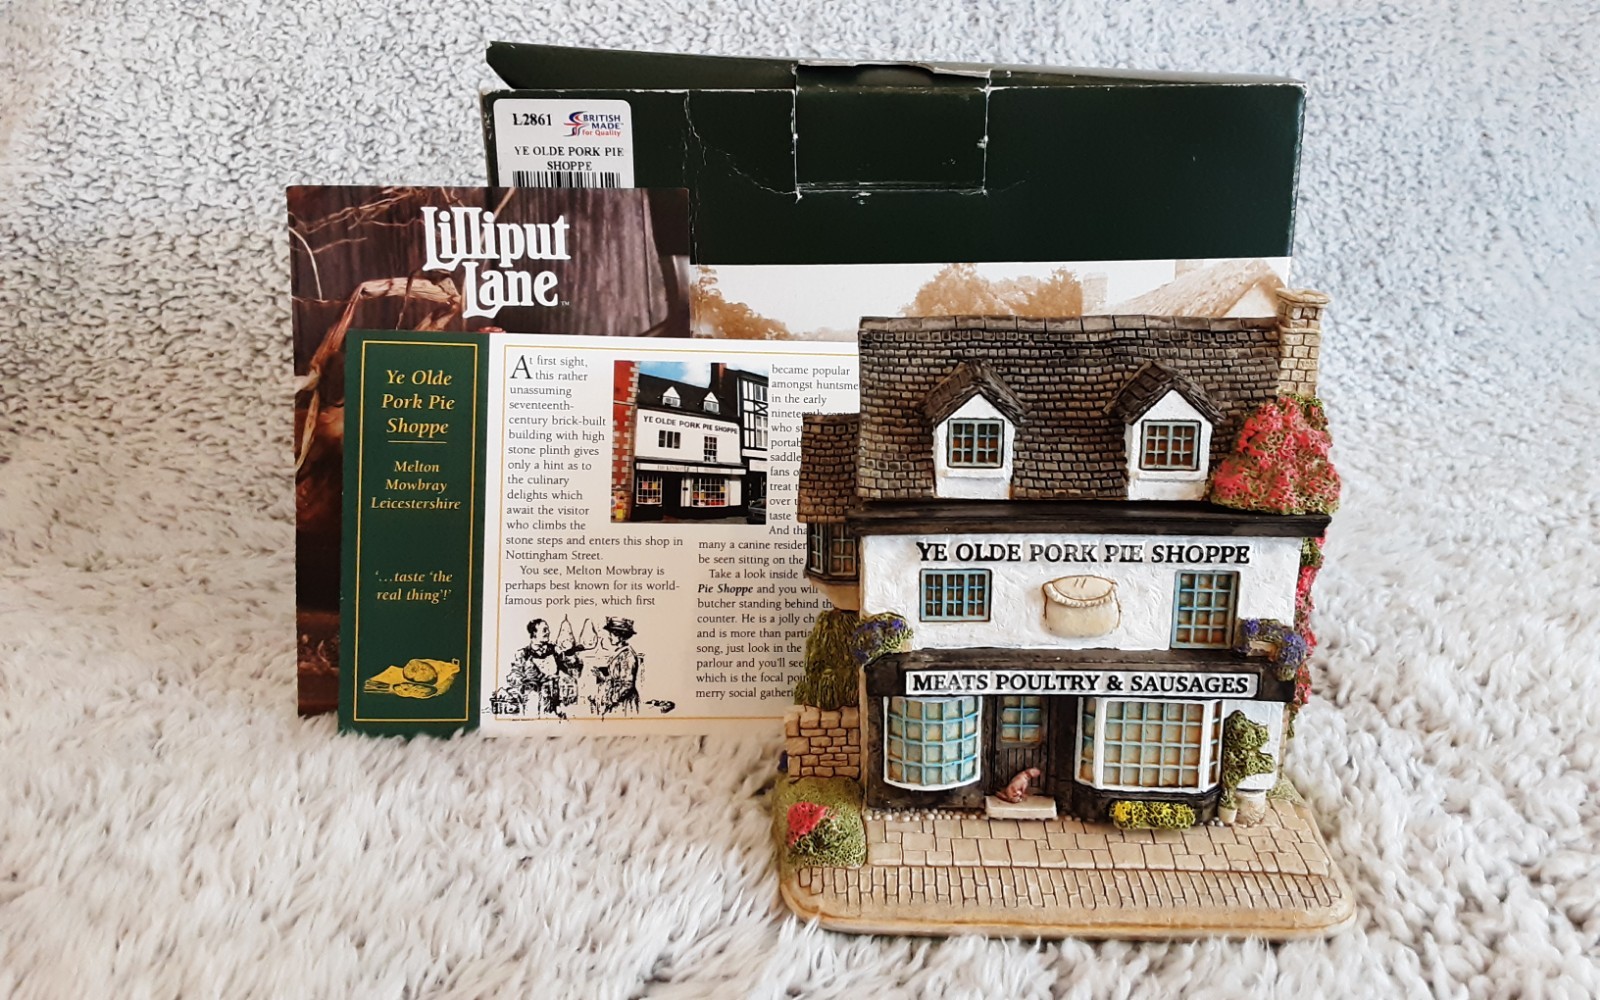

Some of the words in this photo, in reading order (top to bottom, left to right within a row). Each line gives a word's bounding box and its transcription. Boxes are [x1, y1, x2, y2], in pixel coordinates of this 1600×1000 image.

[513, 113, 552, 125] L2861
[515, 146, 529, 155] YE
[533, 147, 564, 155] OLDE
[568, 147, 600, 156] PORK
[605, 148, 624, 156] PIE
[547, 161, 592, 170] SHOPPE
[421, 206, 571, 271] Lilliput
[462, 262, 558, 319] Lane
[537, 356, 556, 365] first
[560, 357, 588, 368] sight,
[772, 364, 808, 374] became
[813, 366, 850, 377] popular
[386, 369, 405, 384] Ye
[412, 369, 452, 385] Olde
[536, 372, 554, 380] this
[558, 372, 588, 381] rather
[771, 380, 812, 391] amongst
[817, 379, 858, 389] huntsme
[510, 386, 572, 397] unassuming
[381, 393, 422, 409] Pork
[428, 395, 455, 409] Pie
[509, 401, 574, 410] seventeenth-
[785, 395, 799, 403] the
[804, 395, 827, 405] early
[509, 417, 547, 427] century
[552, 416, 606, 426] brick-built
[655, 416, 676, 426] OLDE
[679, 420, 700, 429] PORK
[715, 424, 738, 434] SHOPPE
[386, 417, 449, 438] Shoppe
[771, 424, 792, 432] who
[509, 431, 552, 442] building
[556, 432, 578, 440] with
[583, 432, 604, 443] high
[508, 446, 535, 454] stone
[540, 446, 570, 457] plinth
[574, 447, 599, 457] gives
[394, 460, 440, 472] Melton
[508, 461, 531, 472] only
[534, 462, 539, 470] a
[544, 461, 563, 470] hint
[582, 462, 591, 470] to
[770, 467, 789, 477] fans
[385, 479, 447, 494] Mowbray
[508, 475, 524, 484] the
[527, 476, 569, 487] culinary
[770, 483, 791, 491] treat
[507, 491, 547, 501] delights
[552, 492, 583, 500] which
[371, 497, 461, 509] Leicestershire
[507, 506, 533, 514] await
[538, 506, 553, 515] the
[558, 507, 589, 515] visitor
[770, 512, 791, 521] taste
[507, 520, 529, 529] who
[533, 521, 566, 530] climbs
[570, 521, 585, 530] the
[769, 526, 789, 535] And
[506, 536, 533, 544] stone
[537, 536, 563, 547] steps
[566, 536, 585, 545] and
[623, 536, 641, 545] this
[645, 536, 670, 547] shop
[699, 542, 726, 550] many
[506, 550, 567, 562] Nottingham
[572, 551, 603, 560] Street.
[916, 541, 948, 562] YE
[956, 543, 1021, 562] OLDE
[1029, 544, 1097, 563] PORK
[1104, 545, 1143, 563] PIE
[1151, 545, 1251, 564] SHOPPE
[699, 554, 710, 563] be
[739, 555, 769, 566] sitting
[789, 554, 803, 564] the
[520, 566, 539, 575] You
[566, 566, 601, 575] Melton
[606, 566, 653, 577] Mowbray
[657, 567, 664, 575] is
[709, 569, 731, 578] Take
[744, 569, 765, 579] look
[769, 569, 798, 579] inside
[505, 581, 546, 592] perhaps
[550, 581, 570, 590] best
[574, 581, 609, 590] known
[613, 581, 627, 590] for
[631, 581, 642, 590] its
[645, 581, 680, 590] world-
[698, 584, 713, 593] Pie
[717, 584, 753, 595] Shoppe
[757, 584, 775, 593] and
[779, 586, 797, 595] you
[377, 588, 402, 600] real
[505, 595, 542, 605] famous
[546, 596, 570, 607] pork
[574, 596, 597, 607] pies,
[602, 596, 631, 605] which
[636, 596, 655, 605] first
[698, 599, 736, 608] butcher
[739, 599, 781, 610] standing
[785, 599, 818, 608] behind
[697, 615, 737, 624] counter.
[742, 614, 755, 623] He
[759, 615, 766, 623] is
[778, 614, 799, 625] jolly
[697, 629, 715, 638] and
[719, 629, 726, 638] is
[760, 629, 781, 638] than
[697, 645, 723, 654] song,
[726, 644, 744, 655] just
[748, 643, 770, 652] look
[774, 644, 782, 652] in
[787, 643, 801, 652] the
[697, 659, 733, 670] parlour
[736, 659, 754, 667] and
[696, 673, 726, 683] which
[730, 674, 738, 682] is
[741, 673, 757, 682] the
[761, 672, 783, 682] focal
[913, 674, 988, 691] MEATS
[996, 674, 1100, 691] POULTRY
[1106, 675, 1122, 691] &
[1130, 674, 1248, 694] SAUSAGES
[696, 689, 725, 699] merry
[729, 688, 756, 697] social
